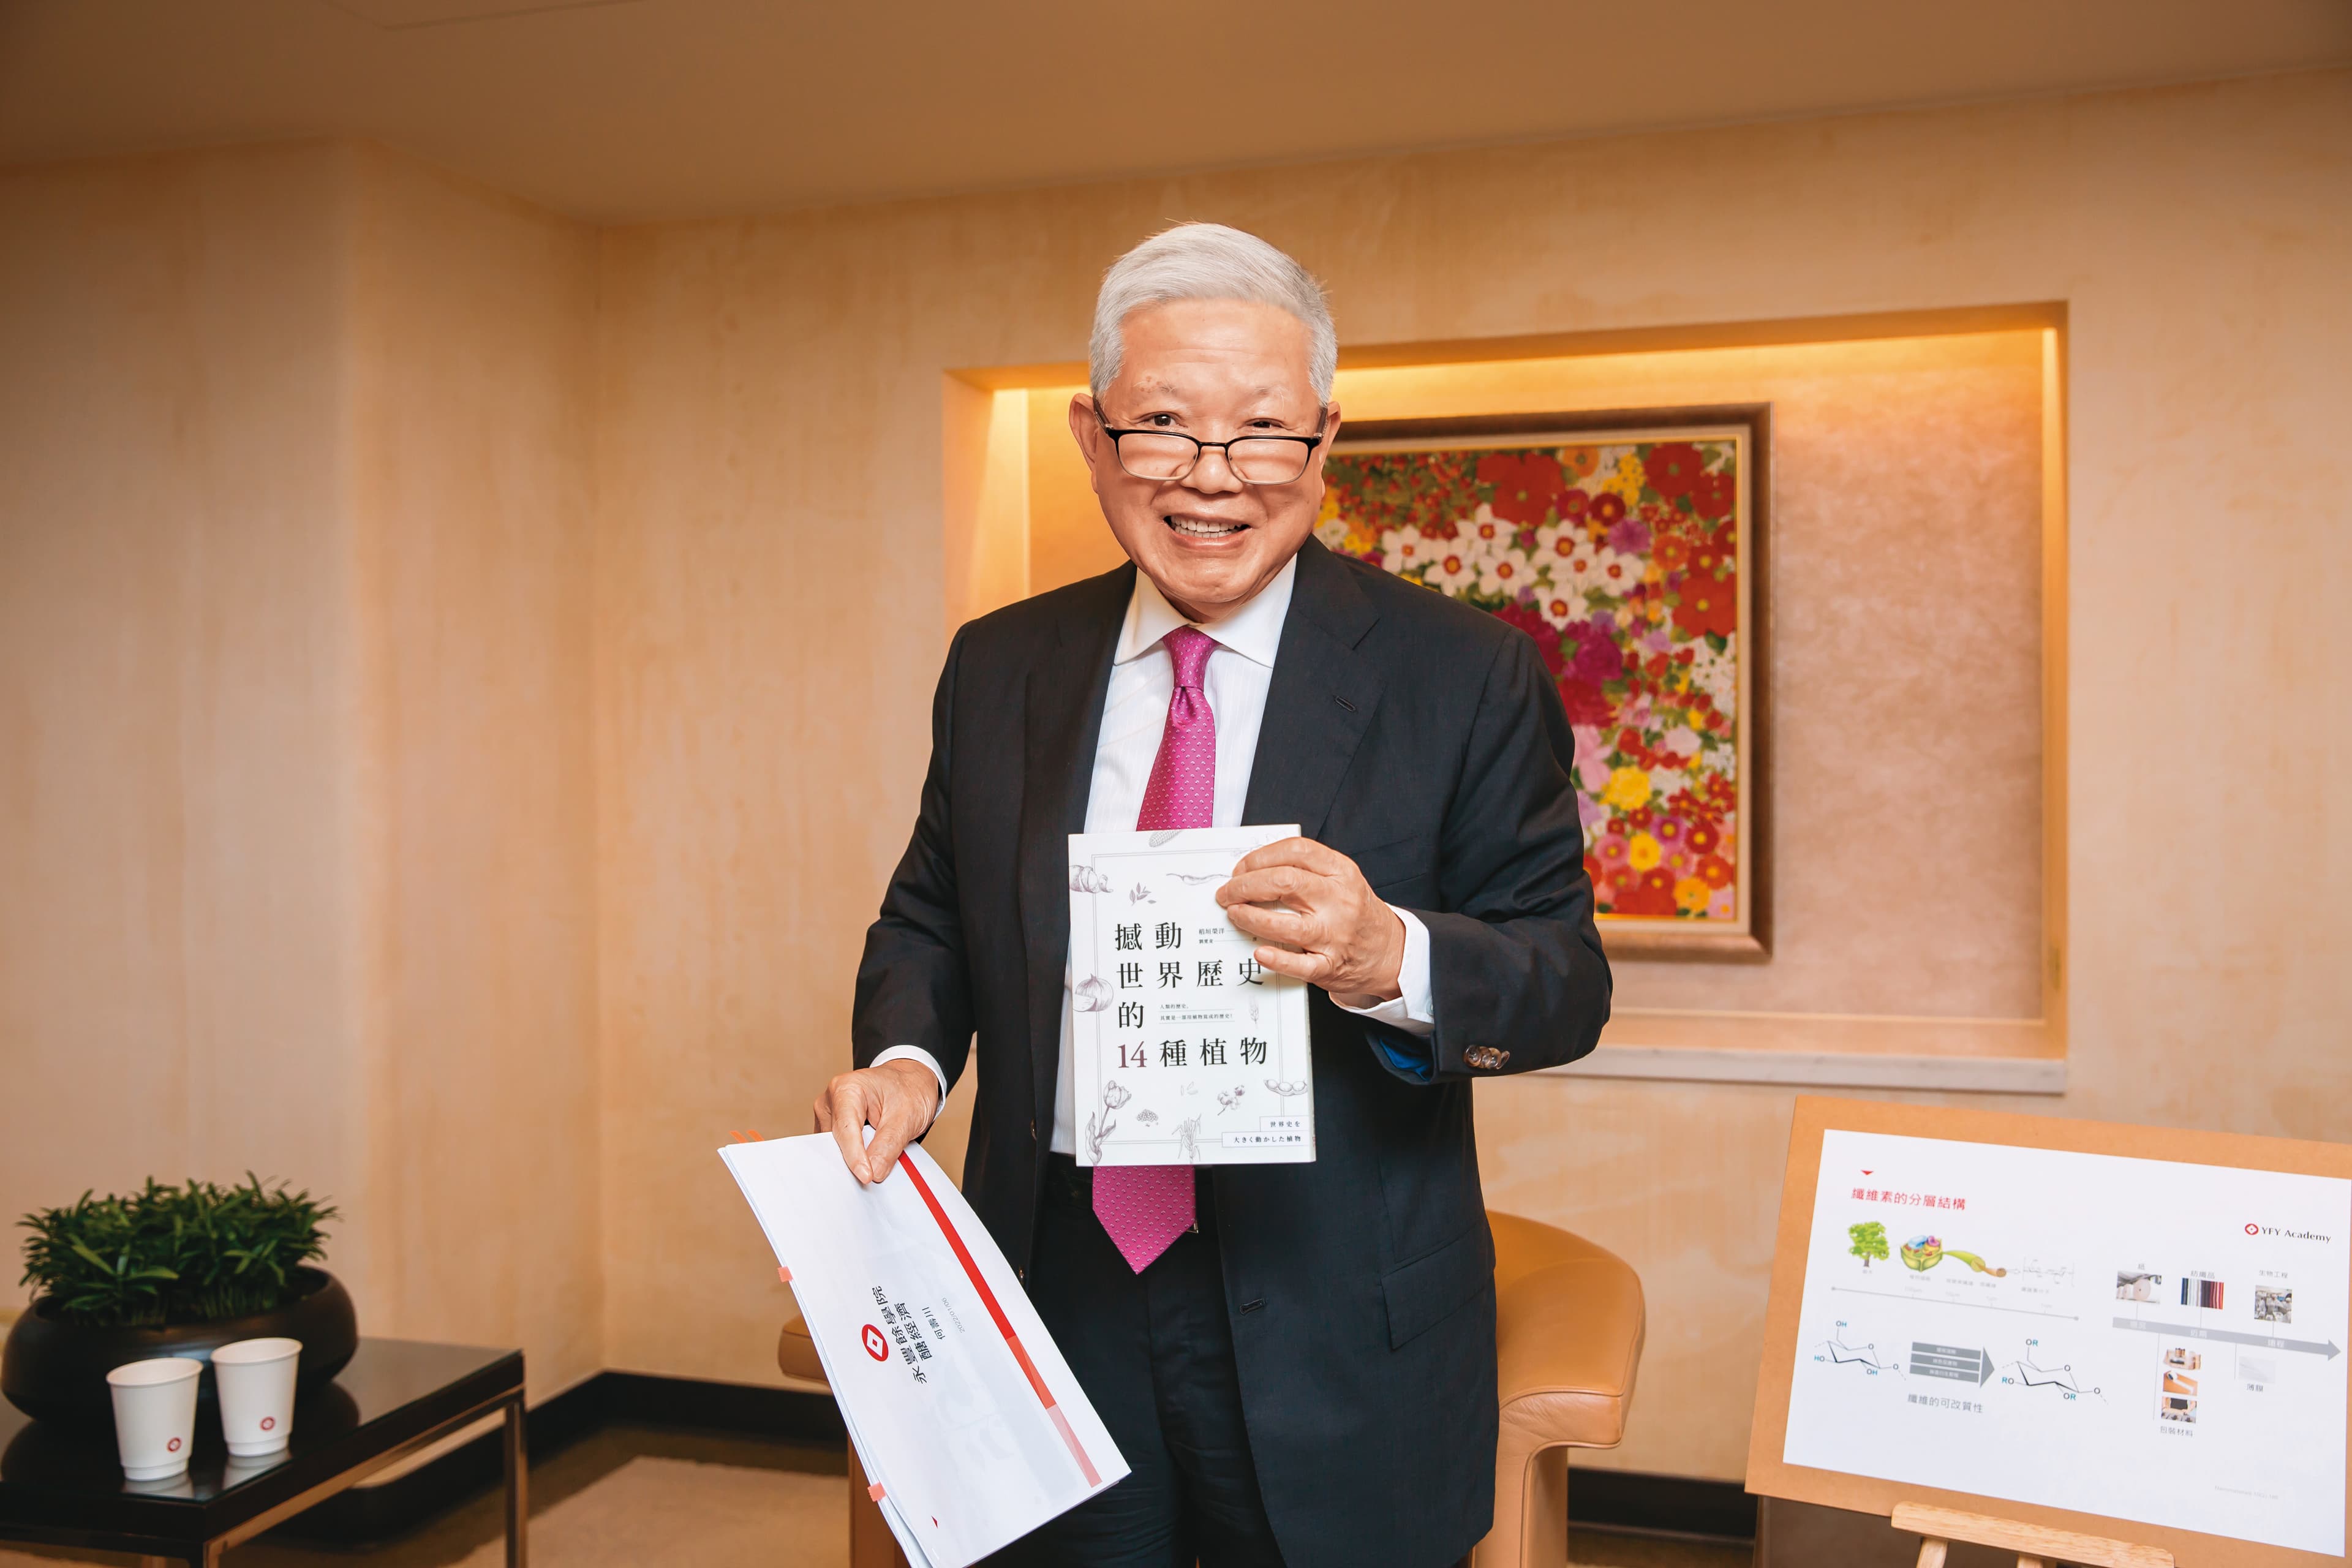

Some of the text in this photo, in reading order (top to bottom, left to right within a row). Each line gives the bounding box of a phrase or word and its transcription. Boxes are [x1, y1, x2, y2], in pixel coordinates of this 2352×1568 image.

[1115, 922, 1182, 951] 撼動
[1117, 958, 1264, 989] 世界歷史
[1118, 1001, 1144, 1029] 的
[1118, 1037, 1267, 1068] 14種植物
[1852, 1188, 1966, 1210] 纖維素的分層結構
[2261, 1227, 2331, 1244] YFY Academy
[921, 1306, 946, 1340] 何壽川
[941, 1297, 965, 1333] 2022/01/06
[872, 1286, 927, 1384] 永豐餘學院
[894, 1302, 932, 1361] 醣經濟
[1907, 1393, 1983, 1414] 纖維的可改質性
